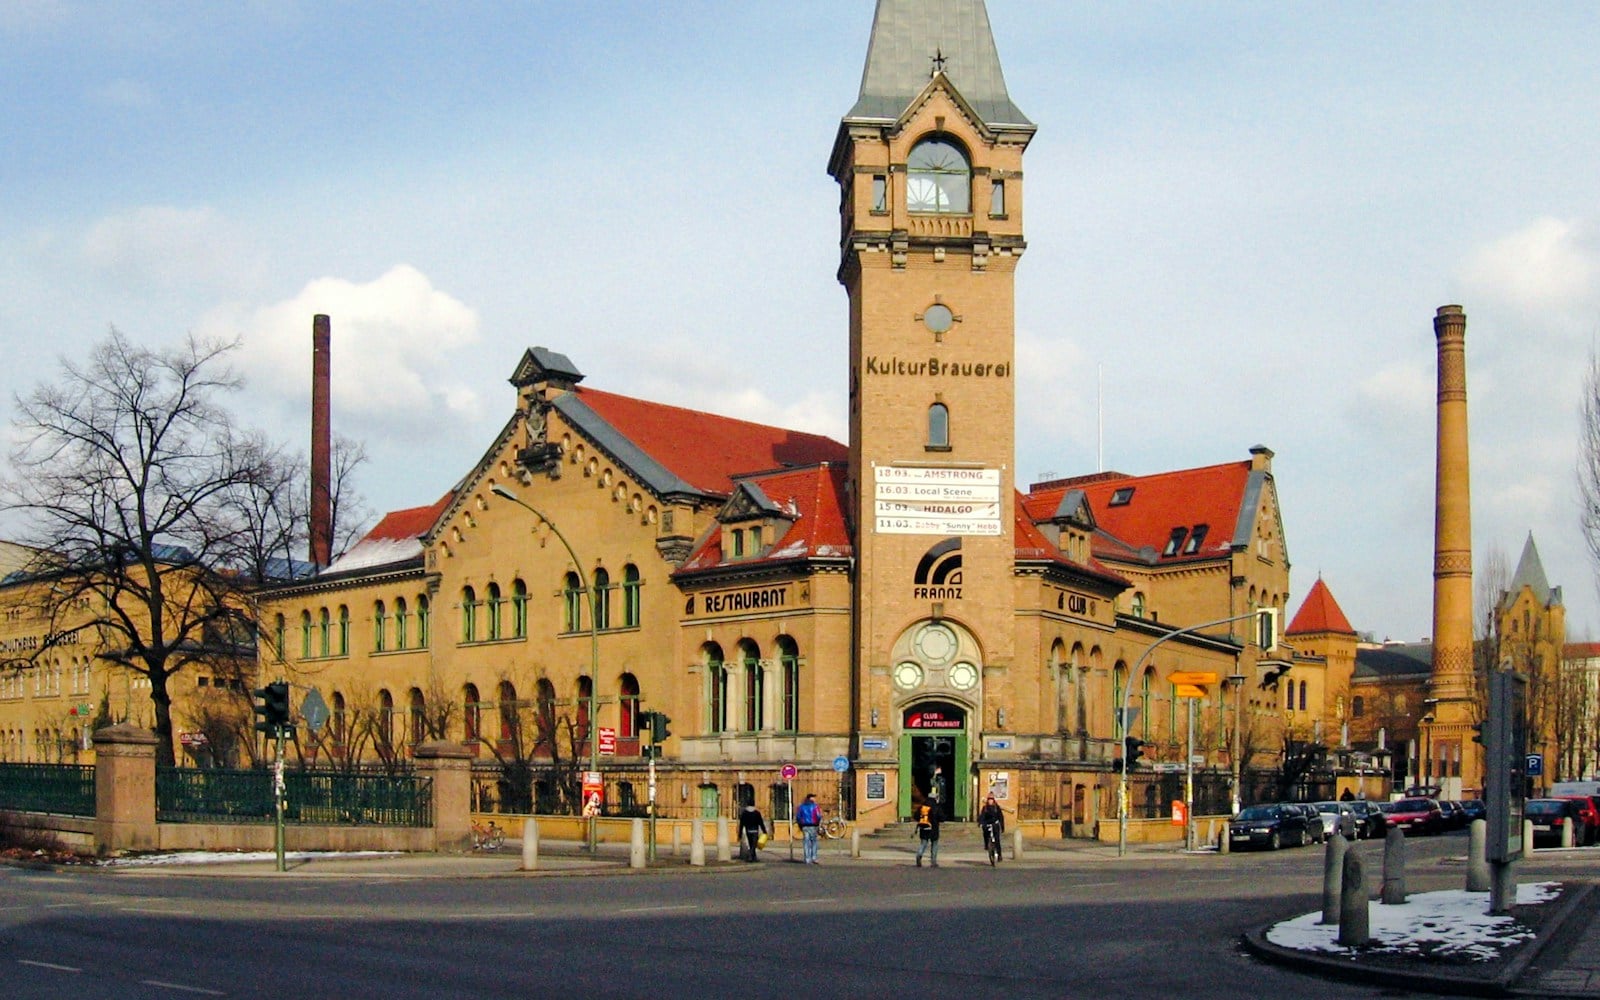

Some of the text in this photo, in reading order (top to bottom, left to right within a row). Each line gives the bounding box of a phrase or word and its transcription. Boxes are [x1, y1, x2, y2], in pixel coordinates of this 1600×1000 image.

[866, 356, 1010, 377] KulturBrauerei
[924, 470, 983, 480] AMSTRONG
[915, 487, 940, 495] Local
[944, 488, 972, 496] Scene
[924, 505, 973, 514] HIDALGO
[914, 587, 963, 599] FRANNZ
[705, 588, 786, 613] RESTAURANT
[1068, 594, 1086, 615] CLUB
[1529, 759, 1538, 768] P
